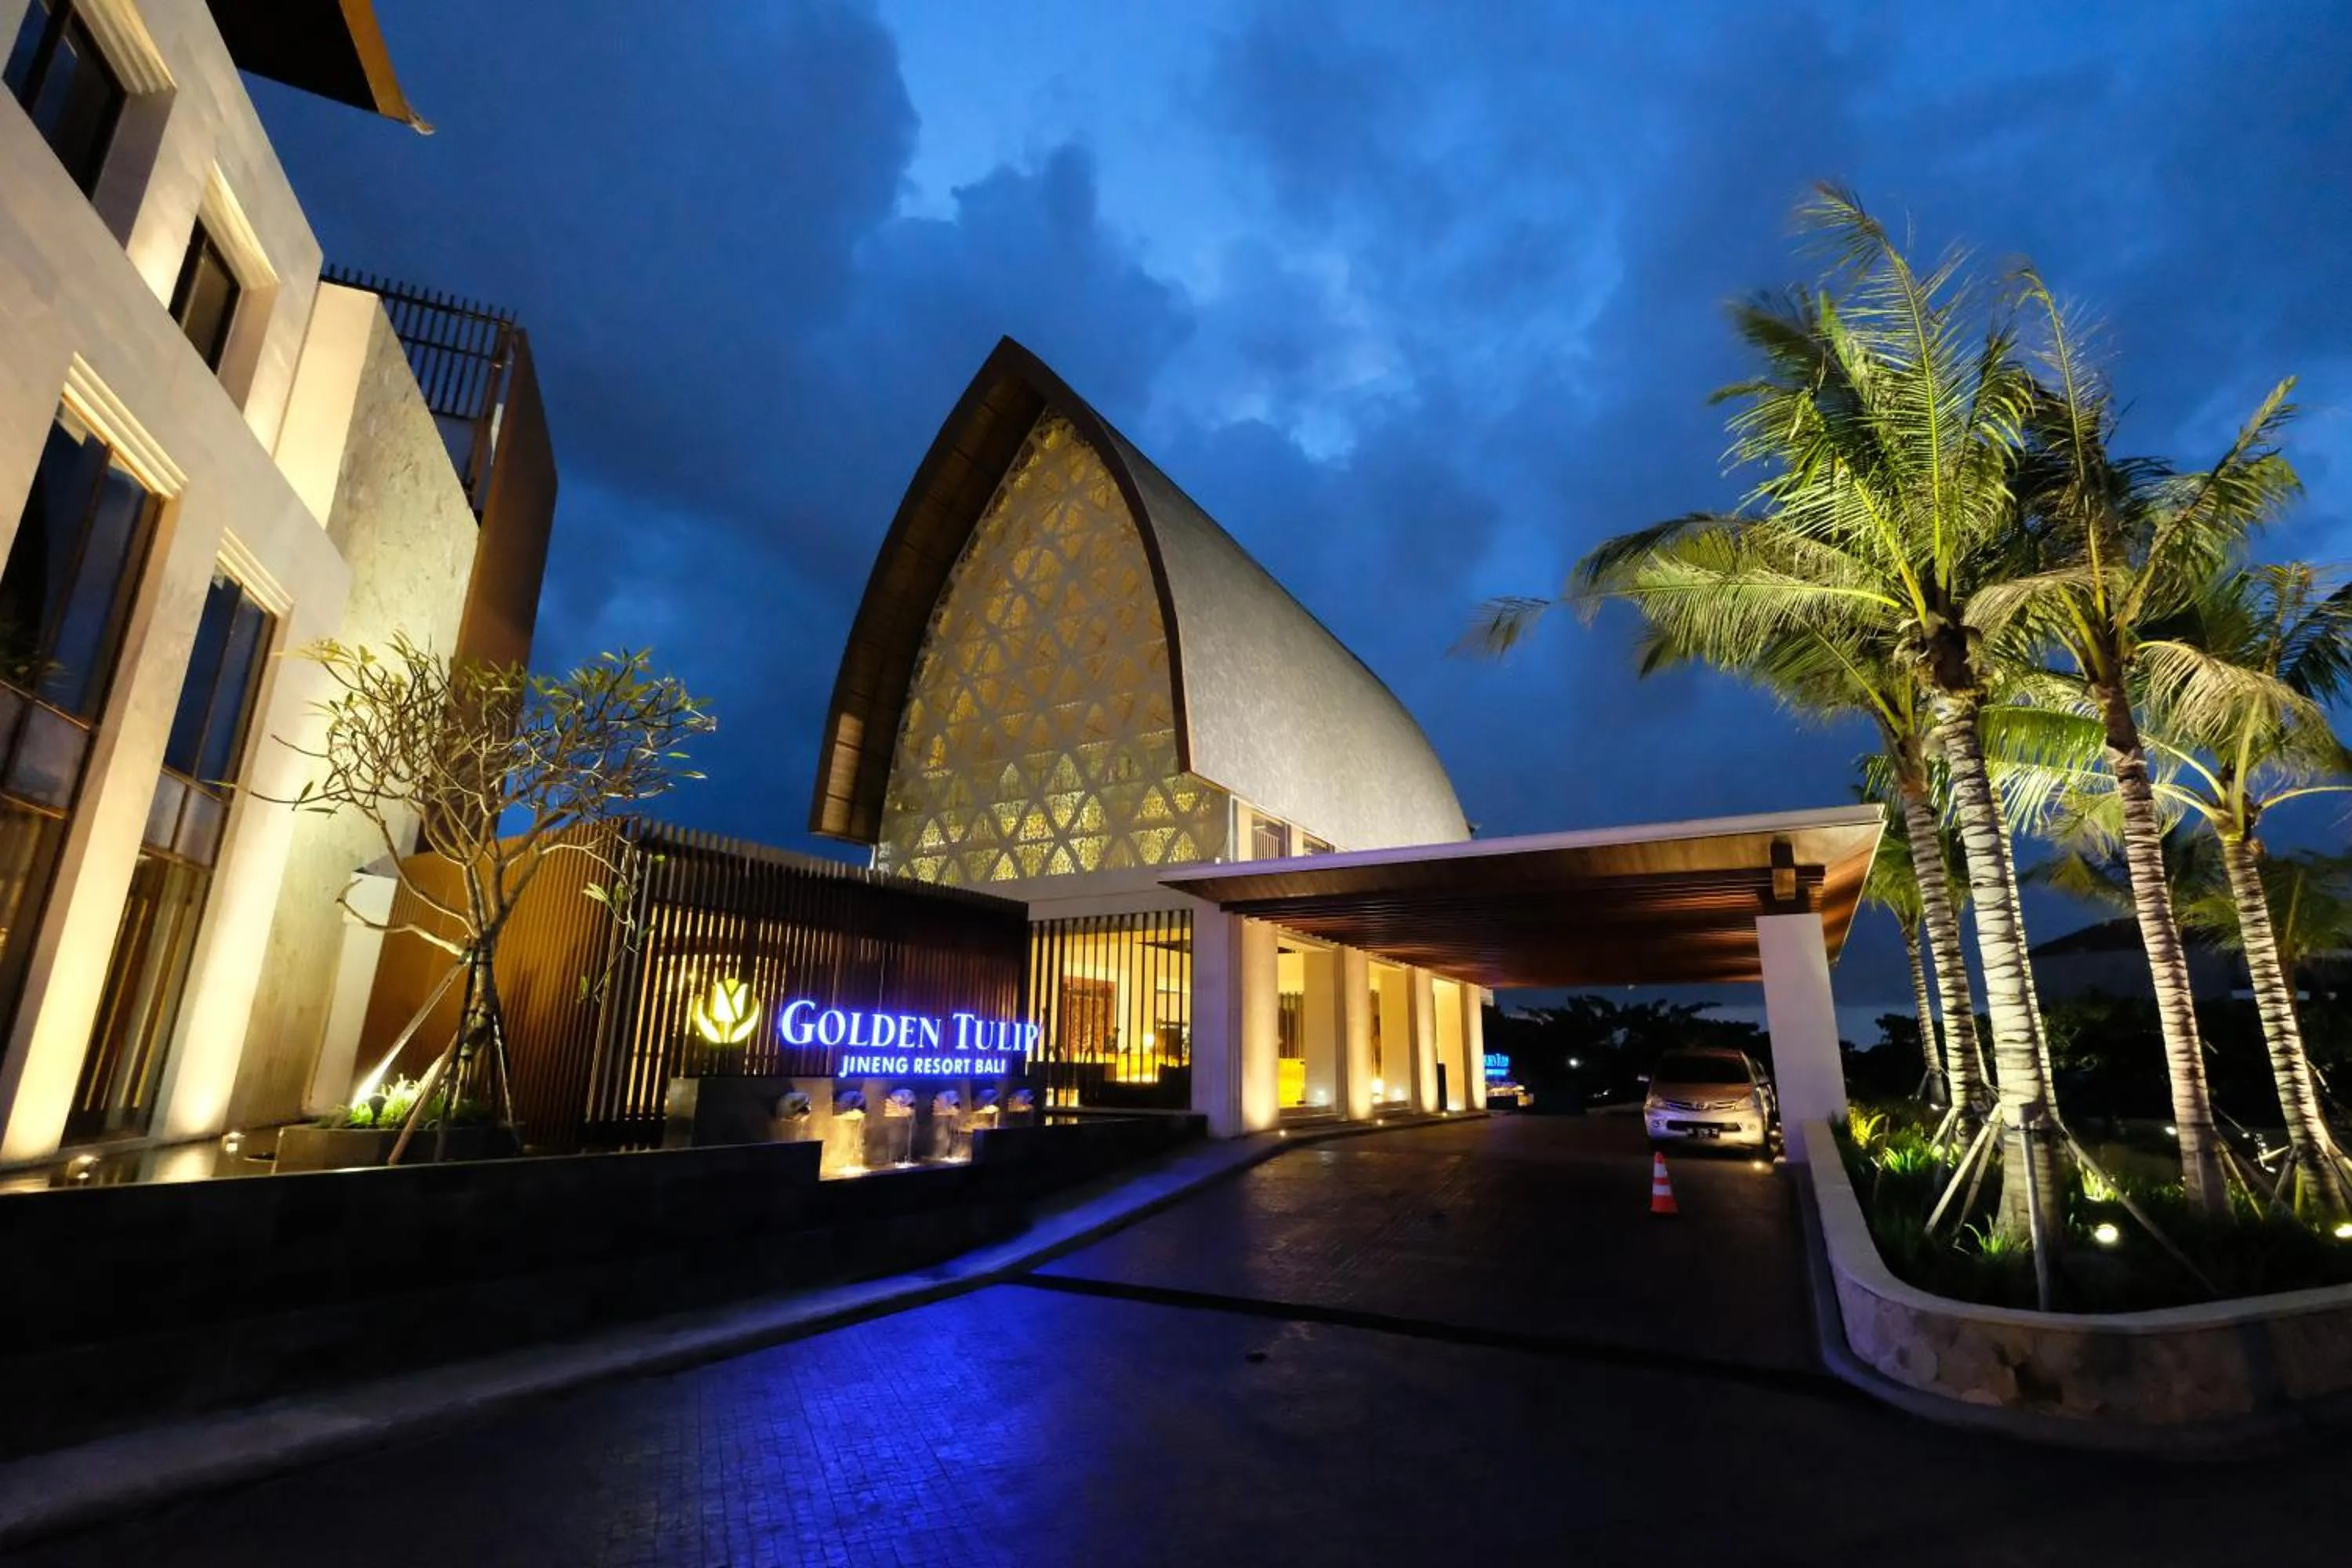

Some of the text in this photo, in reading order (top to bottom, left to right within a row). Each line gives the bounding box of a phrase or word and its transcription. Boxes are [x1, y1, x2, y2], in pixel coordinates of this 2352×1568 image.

[782, 1000, 1039, 1051] GOLDEN TULIP
[838, 1055, 1006, 1077] JINENG RESORT BALI
